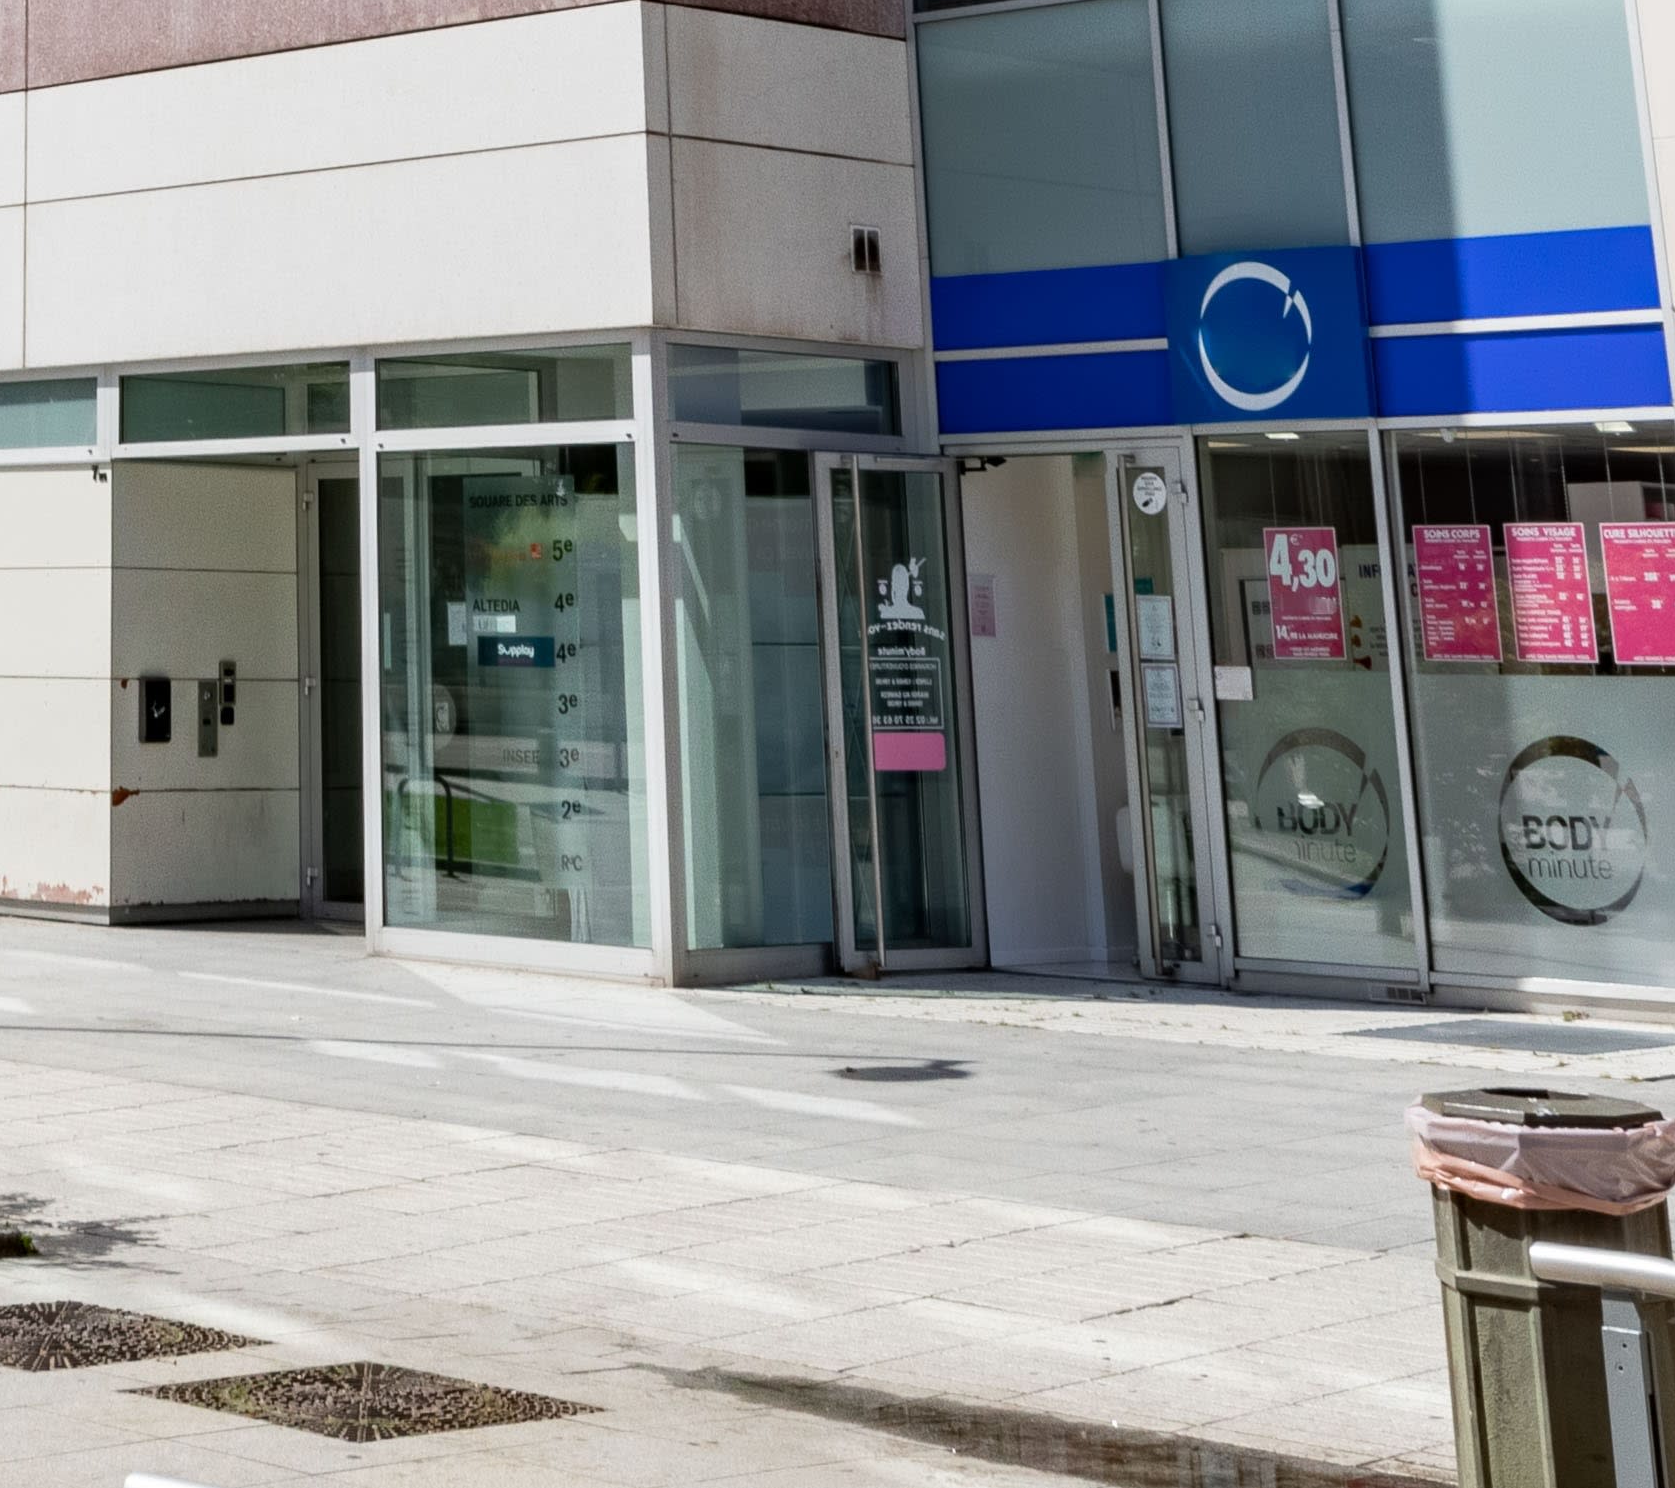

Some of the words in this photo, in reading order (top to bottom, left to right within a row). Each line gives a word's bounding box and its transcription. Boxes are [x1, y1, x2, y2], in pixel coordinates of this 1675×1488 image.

[515, 494, 537, 507] DES
[1423, 529, 1450, 539] SOINS
[1451, 529, 1480, 539] CORPS
[1512, 527, 1540, 538] SOINS
[1542, 527, 1576, 537] VISAGE
[472, 598, 520, 612] ALTEDIA
[502, 749, 541, 765] INSEE
[1277, 801, 1357, 838] BODY
[1522, 814, 1612, 851] BODY
[1292, 838, 1357, 865] inute
[1528, 856, 1613, 880] minute
